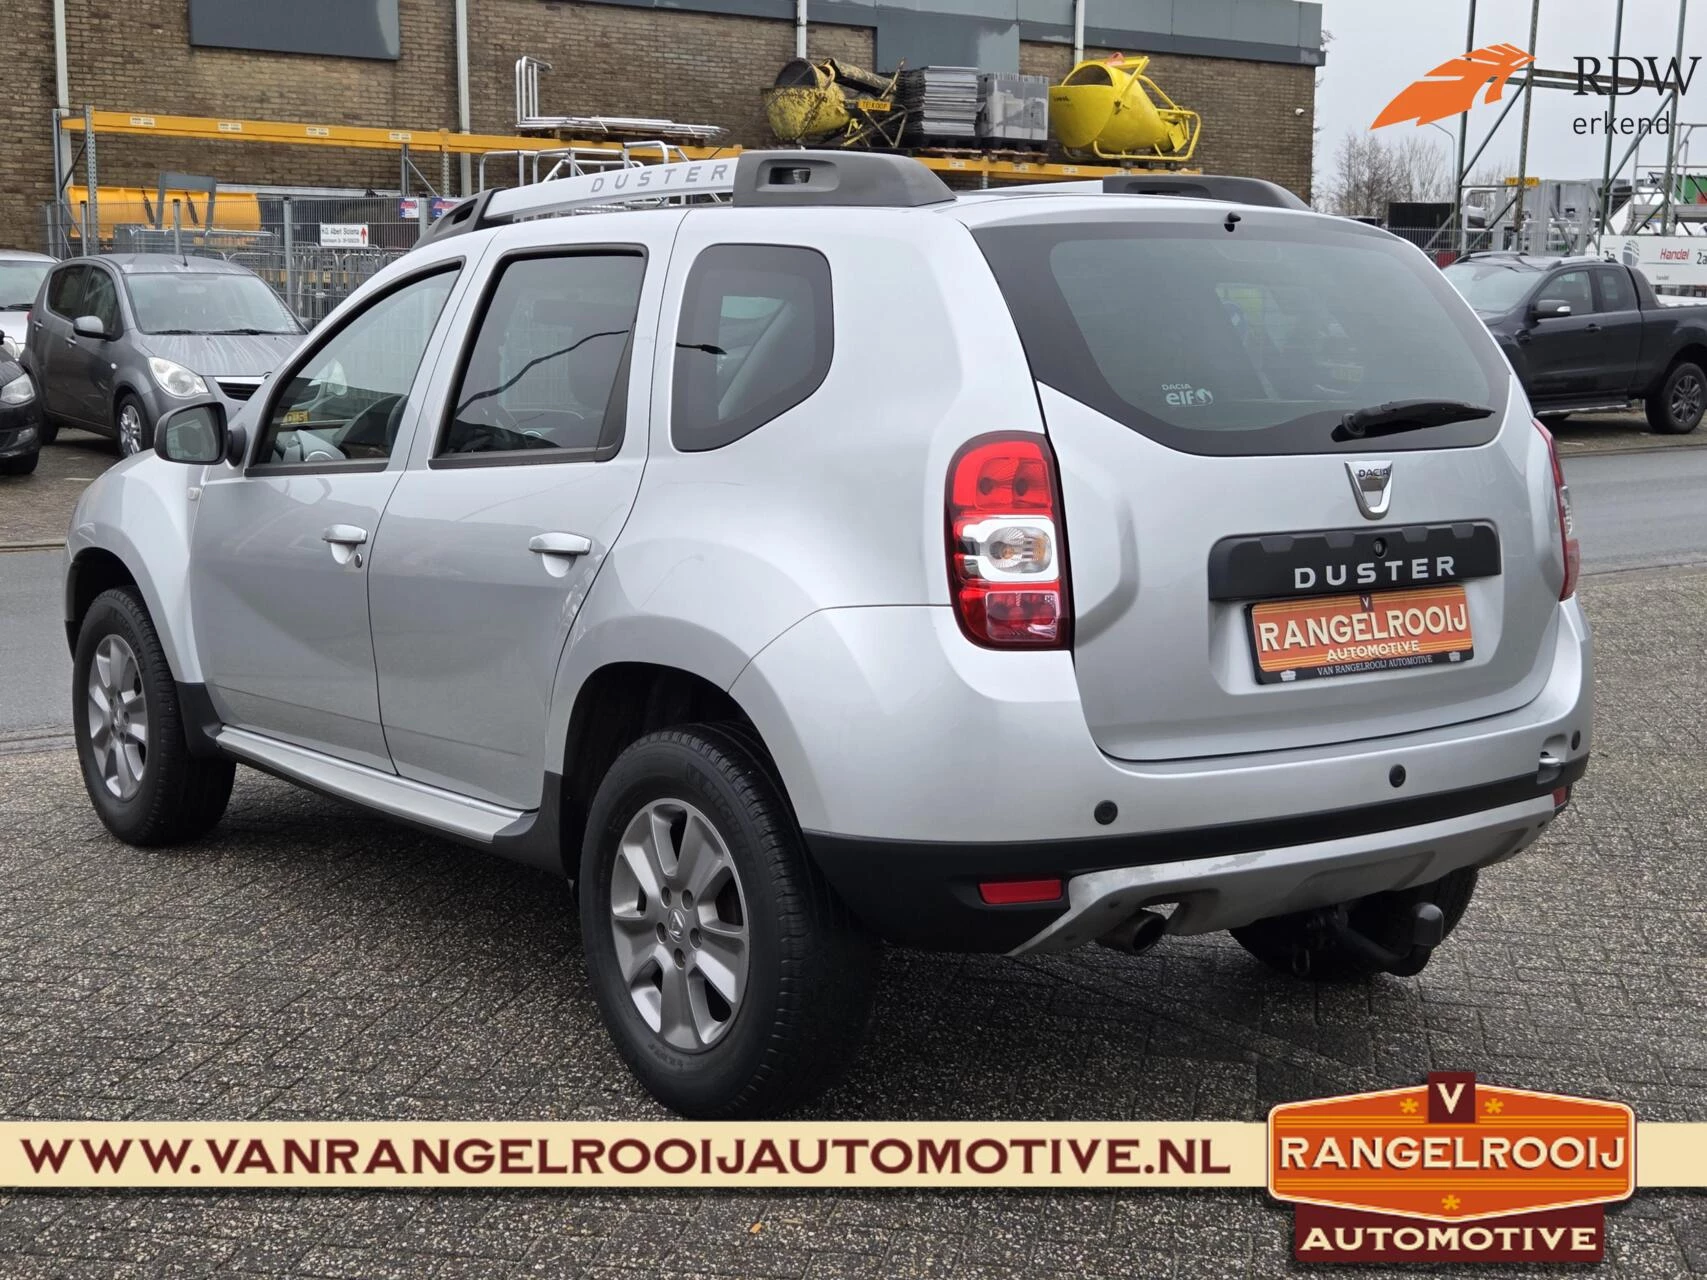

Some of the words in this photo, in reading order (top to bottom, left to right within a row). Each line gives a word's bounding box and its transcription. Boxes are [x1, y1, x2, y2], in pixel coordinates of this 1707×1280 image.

[590, 164, 728, 193] DUSTER
[1660, 248, 1690, 260] Handel
[1166, 390, 1195, 406] elf
[1358, 468, 1389, 478] DACIA
[1294, 556, 1455, 589] DUSTER
[1361, 597, 1370, 608] V
[1258, 604, 1469, 652] RANGELROOIJ
[1326, 640, 1421, 663] AUTOMOTIVE
[1317, 666, 1334, 676] VAN
[1335, 659, 1388, 673] RANGELROOIJ
[1388, 654, 1433, 668] AUTOMOTIVE
